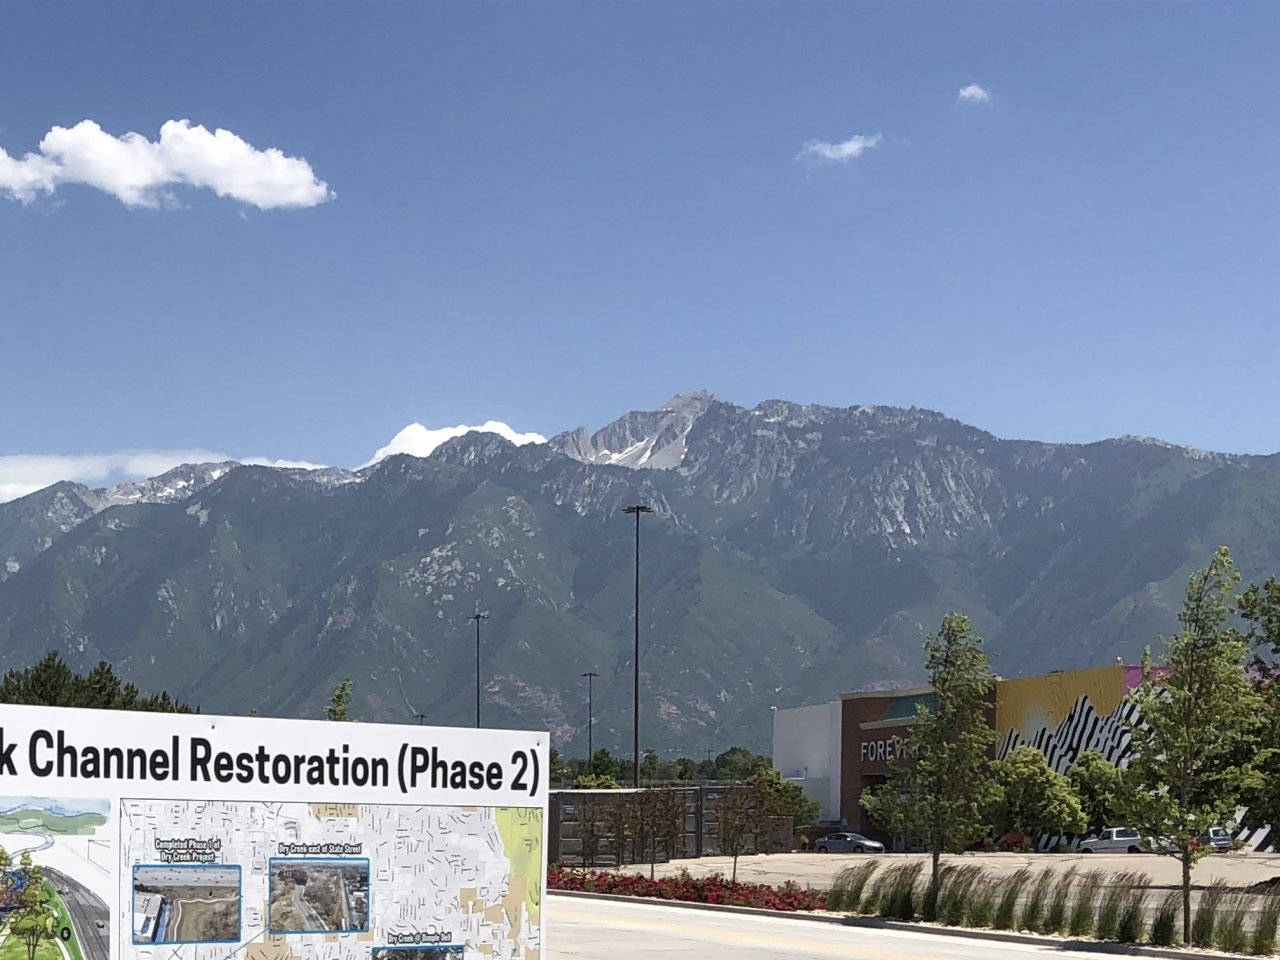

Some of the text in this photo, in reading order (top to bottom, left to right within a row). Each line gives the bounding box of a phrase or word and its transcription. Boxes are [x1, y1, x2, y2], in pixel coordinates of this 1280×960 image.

[29, 729, 179, 781] Channel
[190, 737, 389, 787] Restoration
[398, 743, 503, 793] (Phase
[510, 749, 540, 797] 2)
[155, 838, 188, 850] Completed
[188, 839, 207, 849] Phase
[213, 839, 221, 850] of
[278, 843, 290, 855] Dry
[290, 843, 308, 854] Creek
[308, 844, 320, 854] east
[328, 843, 344, 854] State
[344, 843, 362, 854] Street
[160, 851, 215, 863] Dry Creek Project
